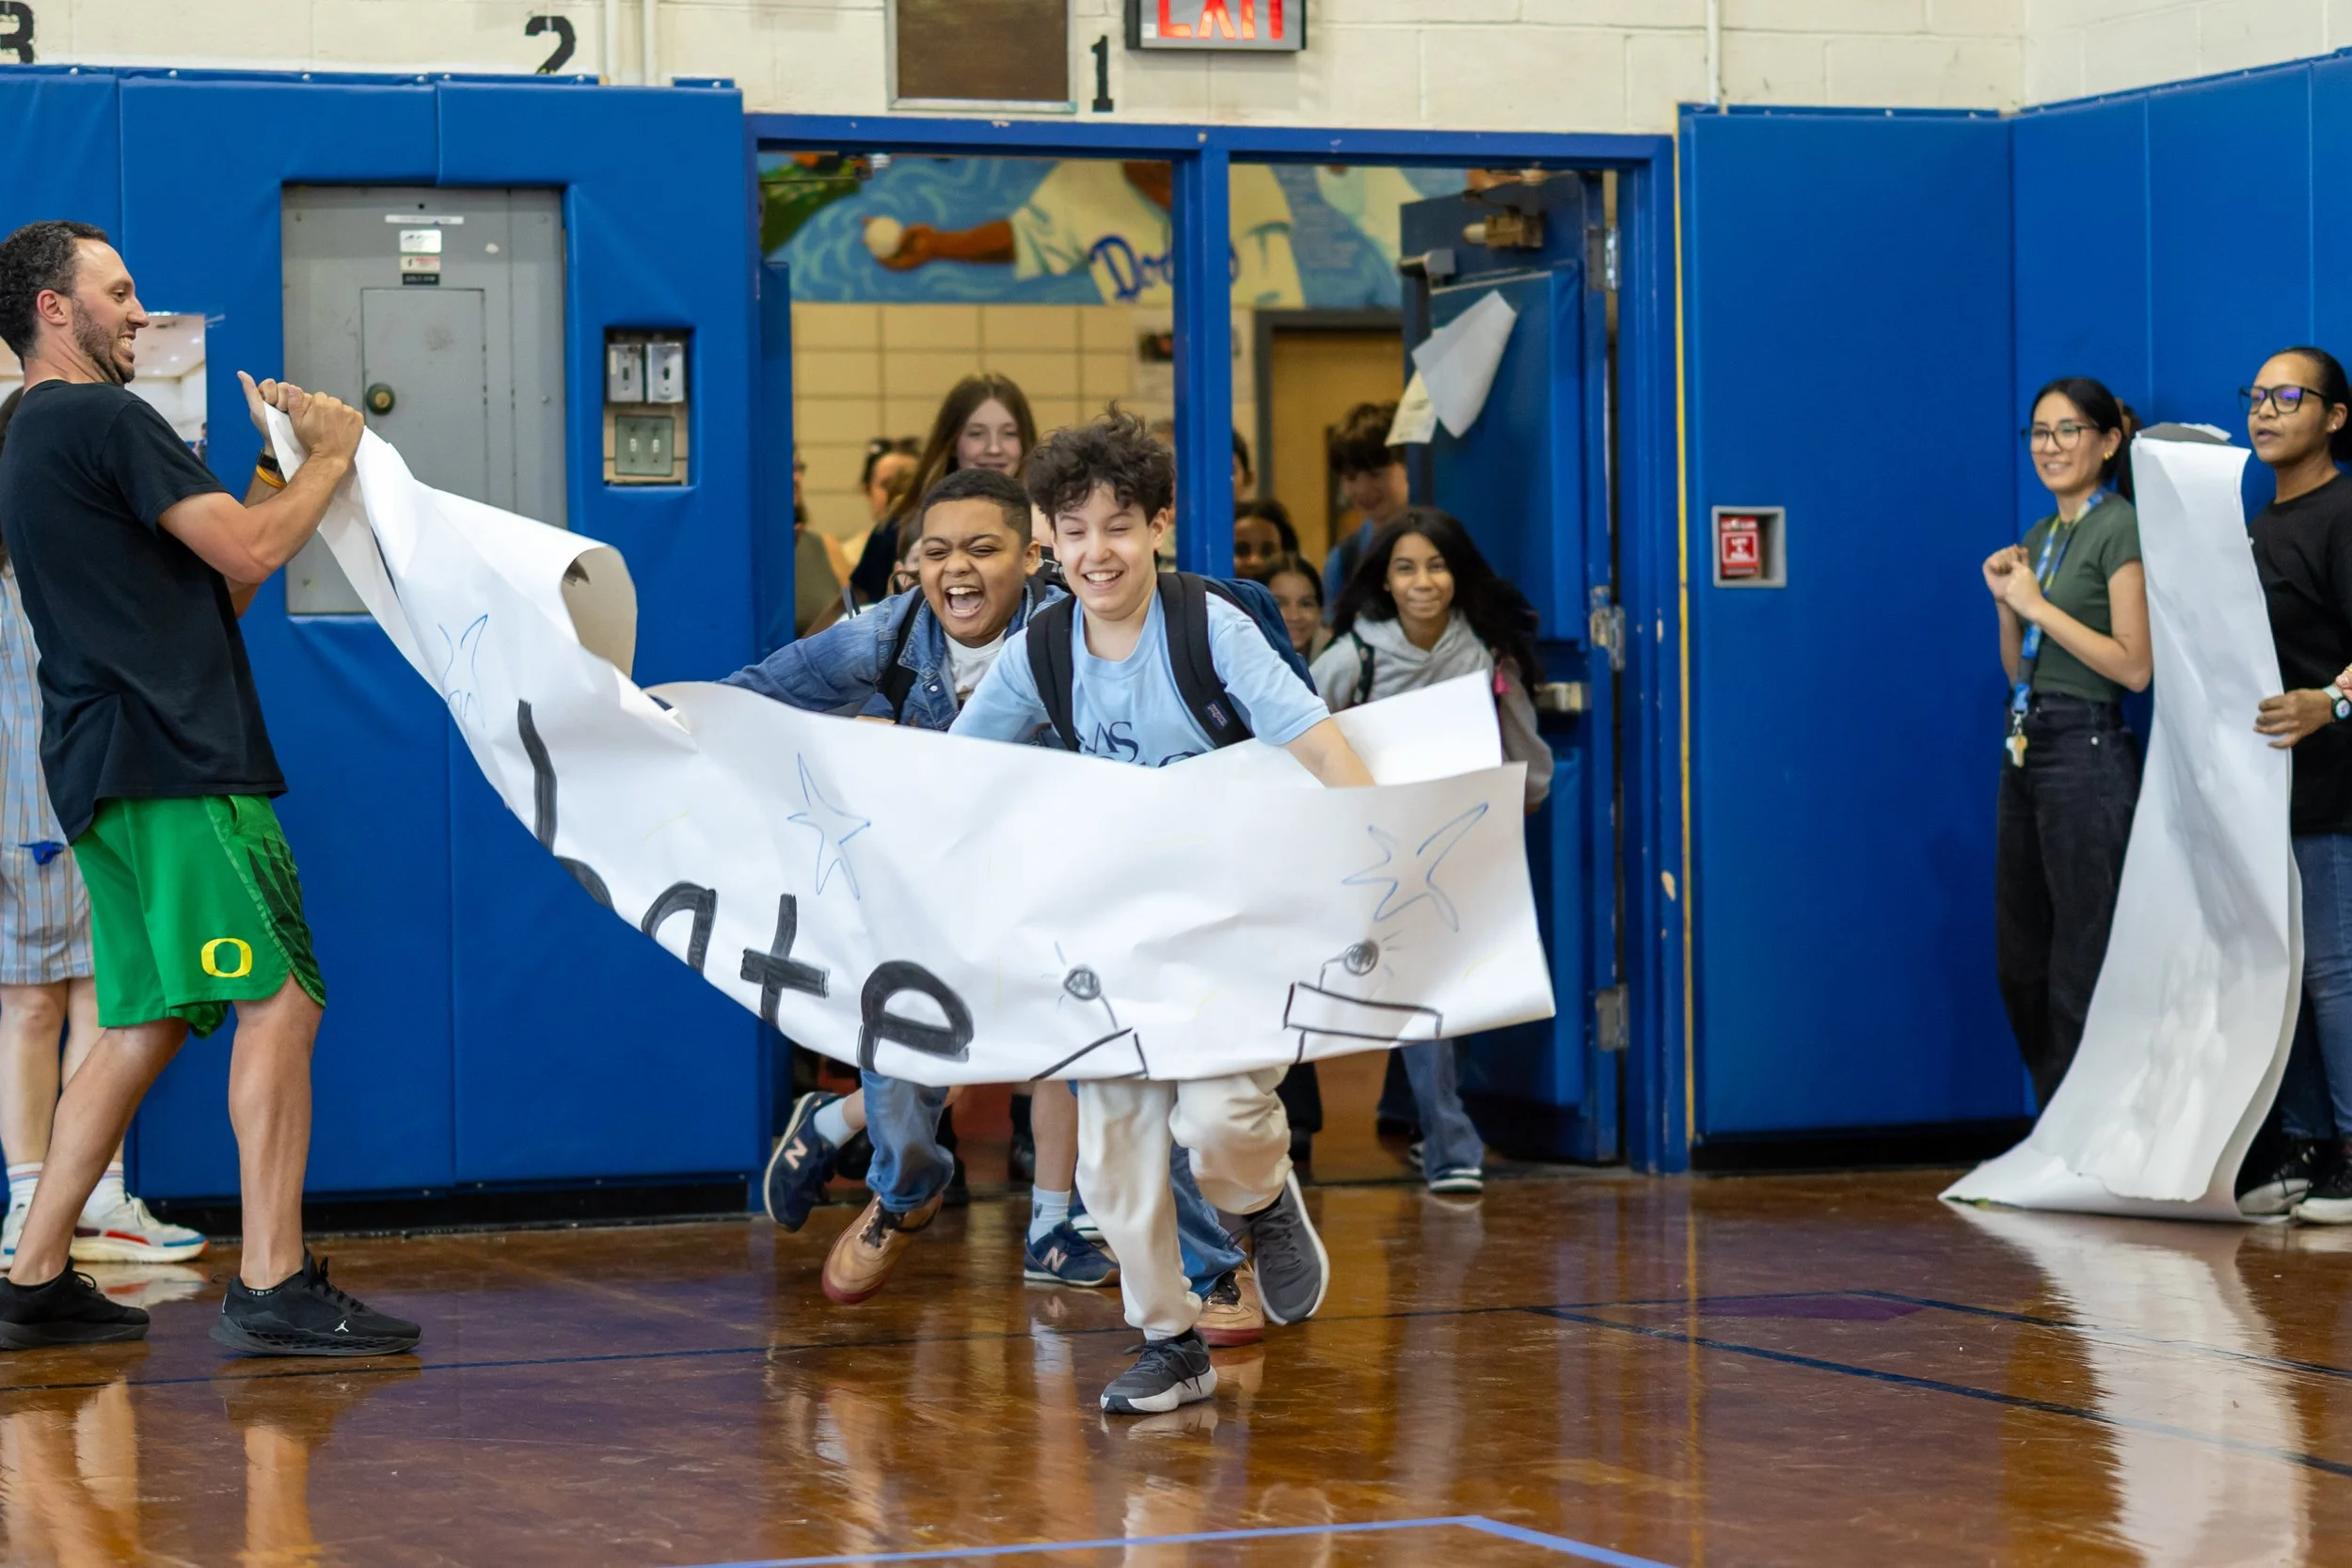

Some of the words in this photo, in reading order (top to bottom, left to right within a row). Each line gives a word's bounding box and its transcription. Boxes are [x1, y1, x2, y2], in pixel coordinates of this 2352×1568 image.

[1158, 0, 1284, 40] EXIT
[525, 15, 576, 74] 2
[1090, 35, 1114, 112] 1
[200, 937, 253, 978] O
[1041, 1246, 1068, 1273] N
